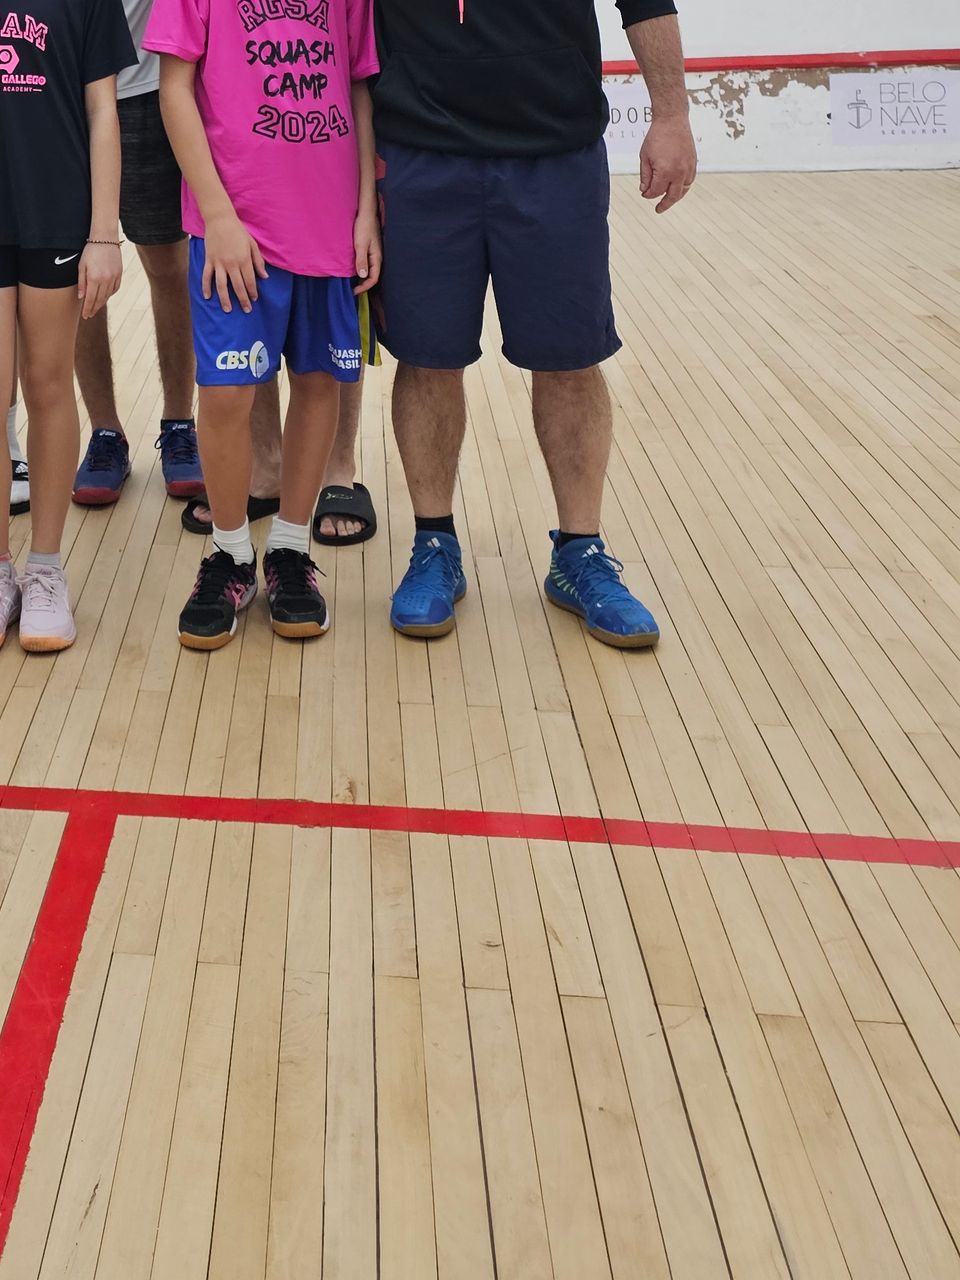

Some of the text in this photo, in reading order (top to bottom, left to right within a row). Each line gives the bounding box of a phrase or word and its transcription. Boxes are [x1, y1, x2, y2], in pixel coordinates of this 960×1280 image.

[245, 38, 337, 68] SQUASH
[1, 74, 47, 86] GALLEGO
[2, 85, 33, 93] ACADEMY
[263, 72, 328, 102] CAMP
[880, 80, 946, 104] BELO
[252, 104, 349, 144] 2024
[880, 104, 947, 126] NAVE
[215, 350, 249, 370] CBS
